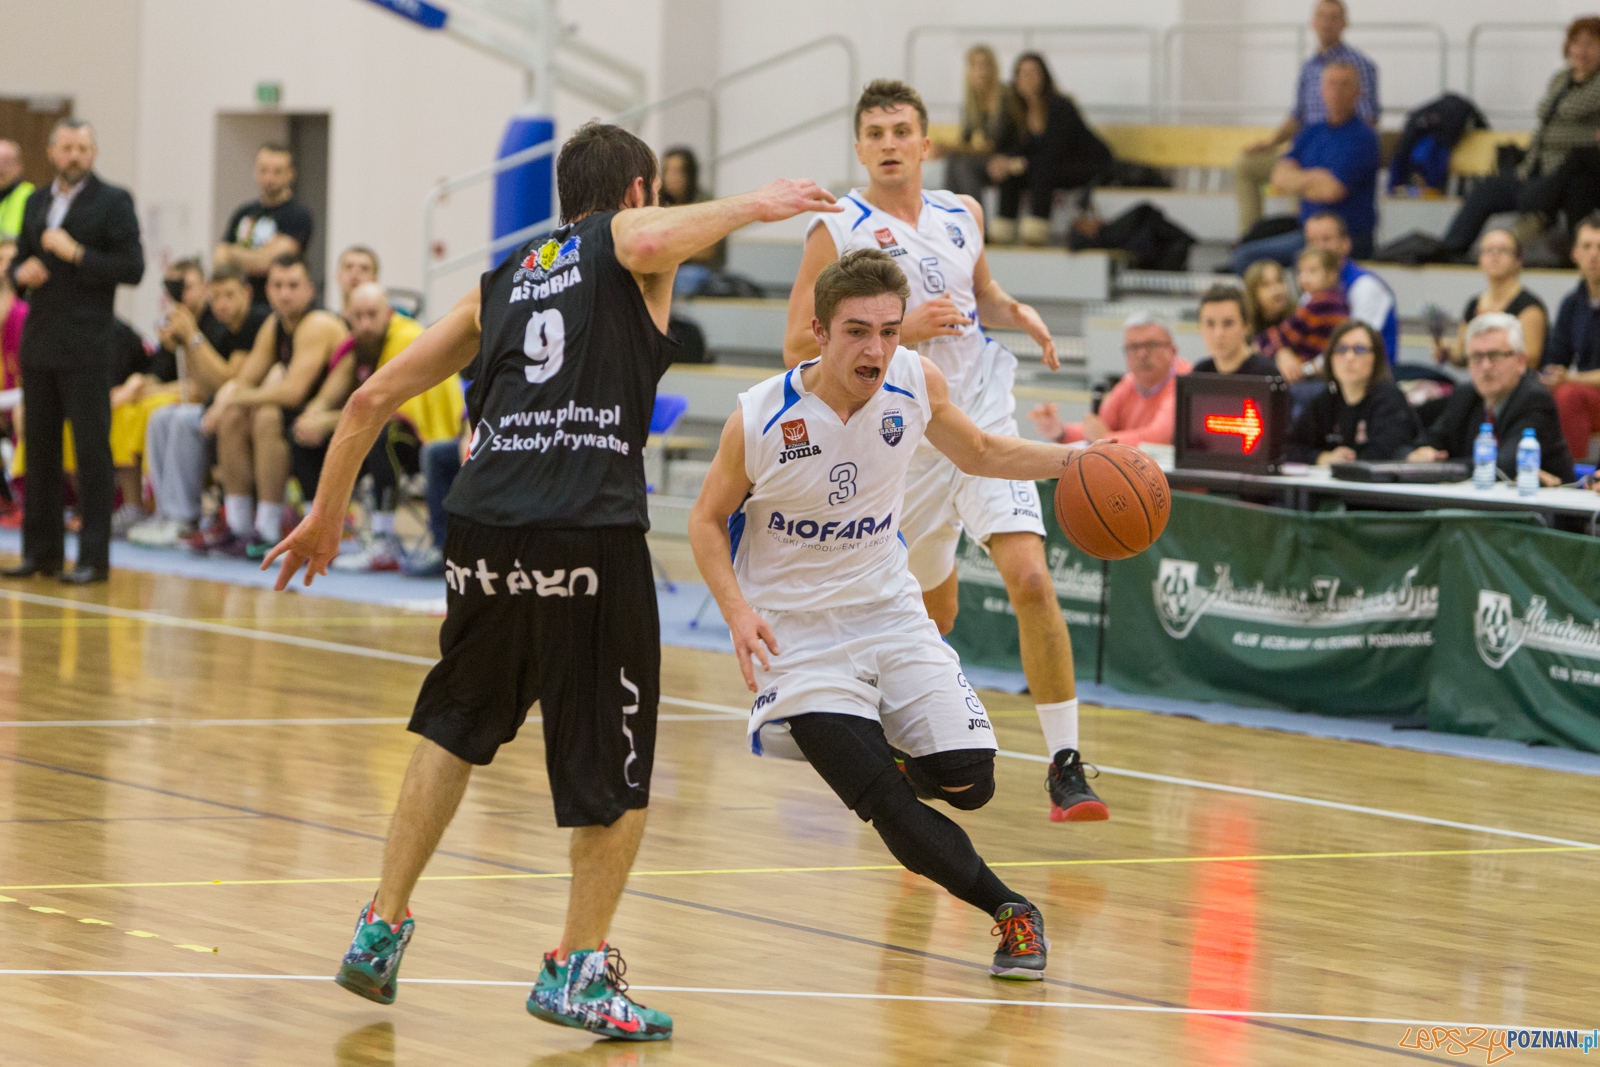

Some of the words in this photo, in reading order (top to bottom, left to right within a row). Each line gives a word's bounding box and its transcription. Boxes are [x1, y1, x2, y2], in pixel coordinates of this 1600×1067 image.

[890, 248, 908, 258] ma
[509, 265, 582, 304] ASTORIA
[919, 257, 946, 294] 6
[523, 308, 566, 384] 9
[499, 400, 621, 429] www.plm.pl
[491, 432, 553, 453] Szkoły
[552, 429, 630, 456] Prywatne
[779, 445, 822, 464] Joma
[828, 461, 858, 506] 3
